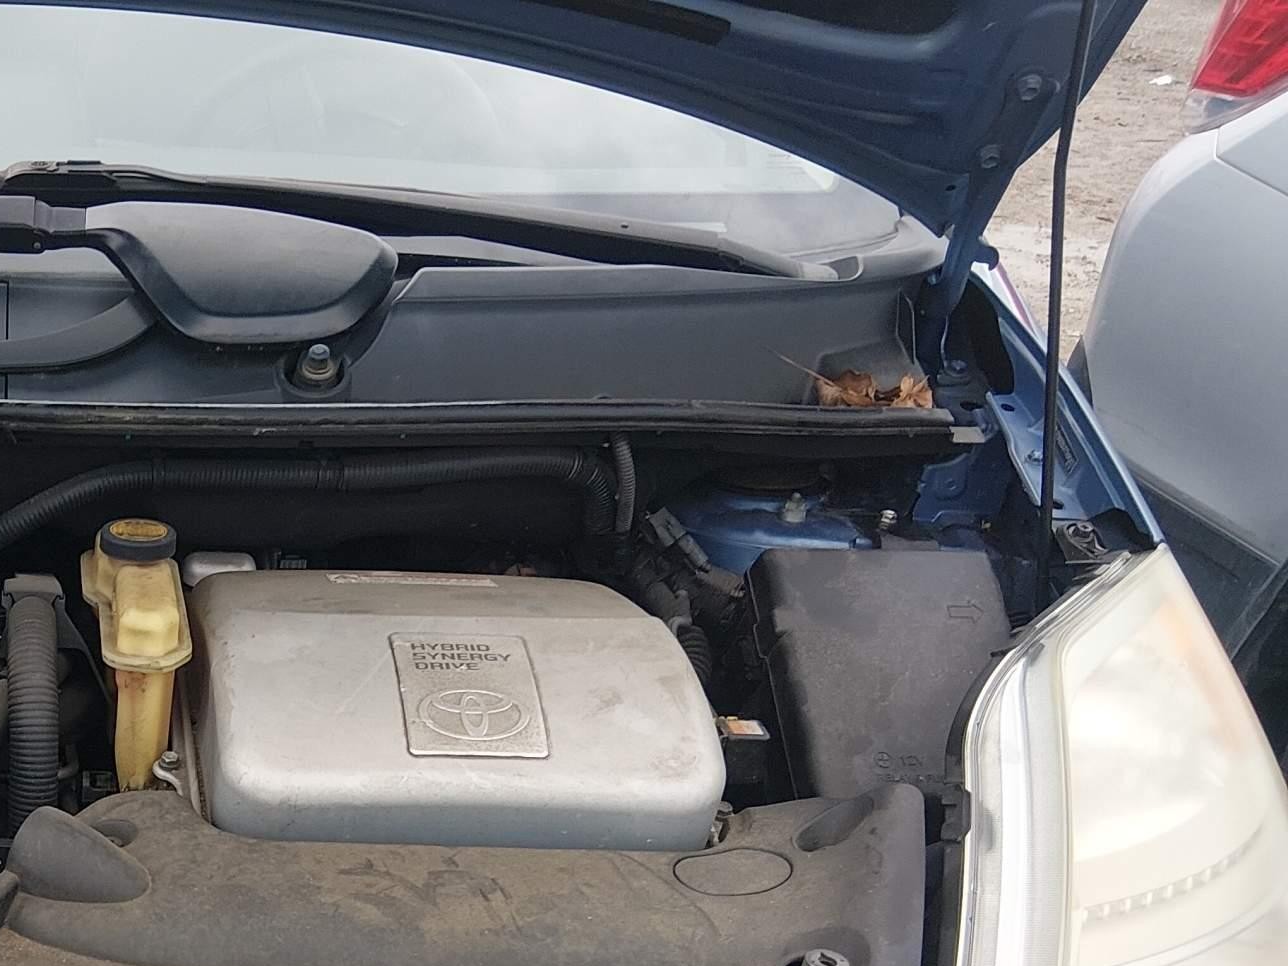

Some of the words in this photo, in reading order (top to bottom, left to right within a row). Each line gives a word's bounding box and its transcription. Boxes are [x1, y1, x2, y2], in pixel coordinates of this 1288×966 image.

[410, 642, 491, 652] HYBRID
[411, 652, 511, 662] SYNERGY
[414, 661, 481, 671] DRIVE
